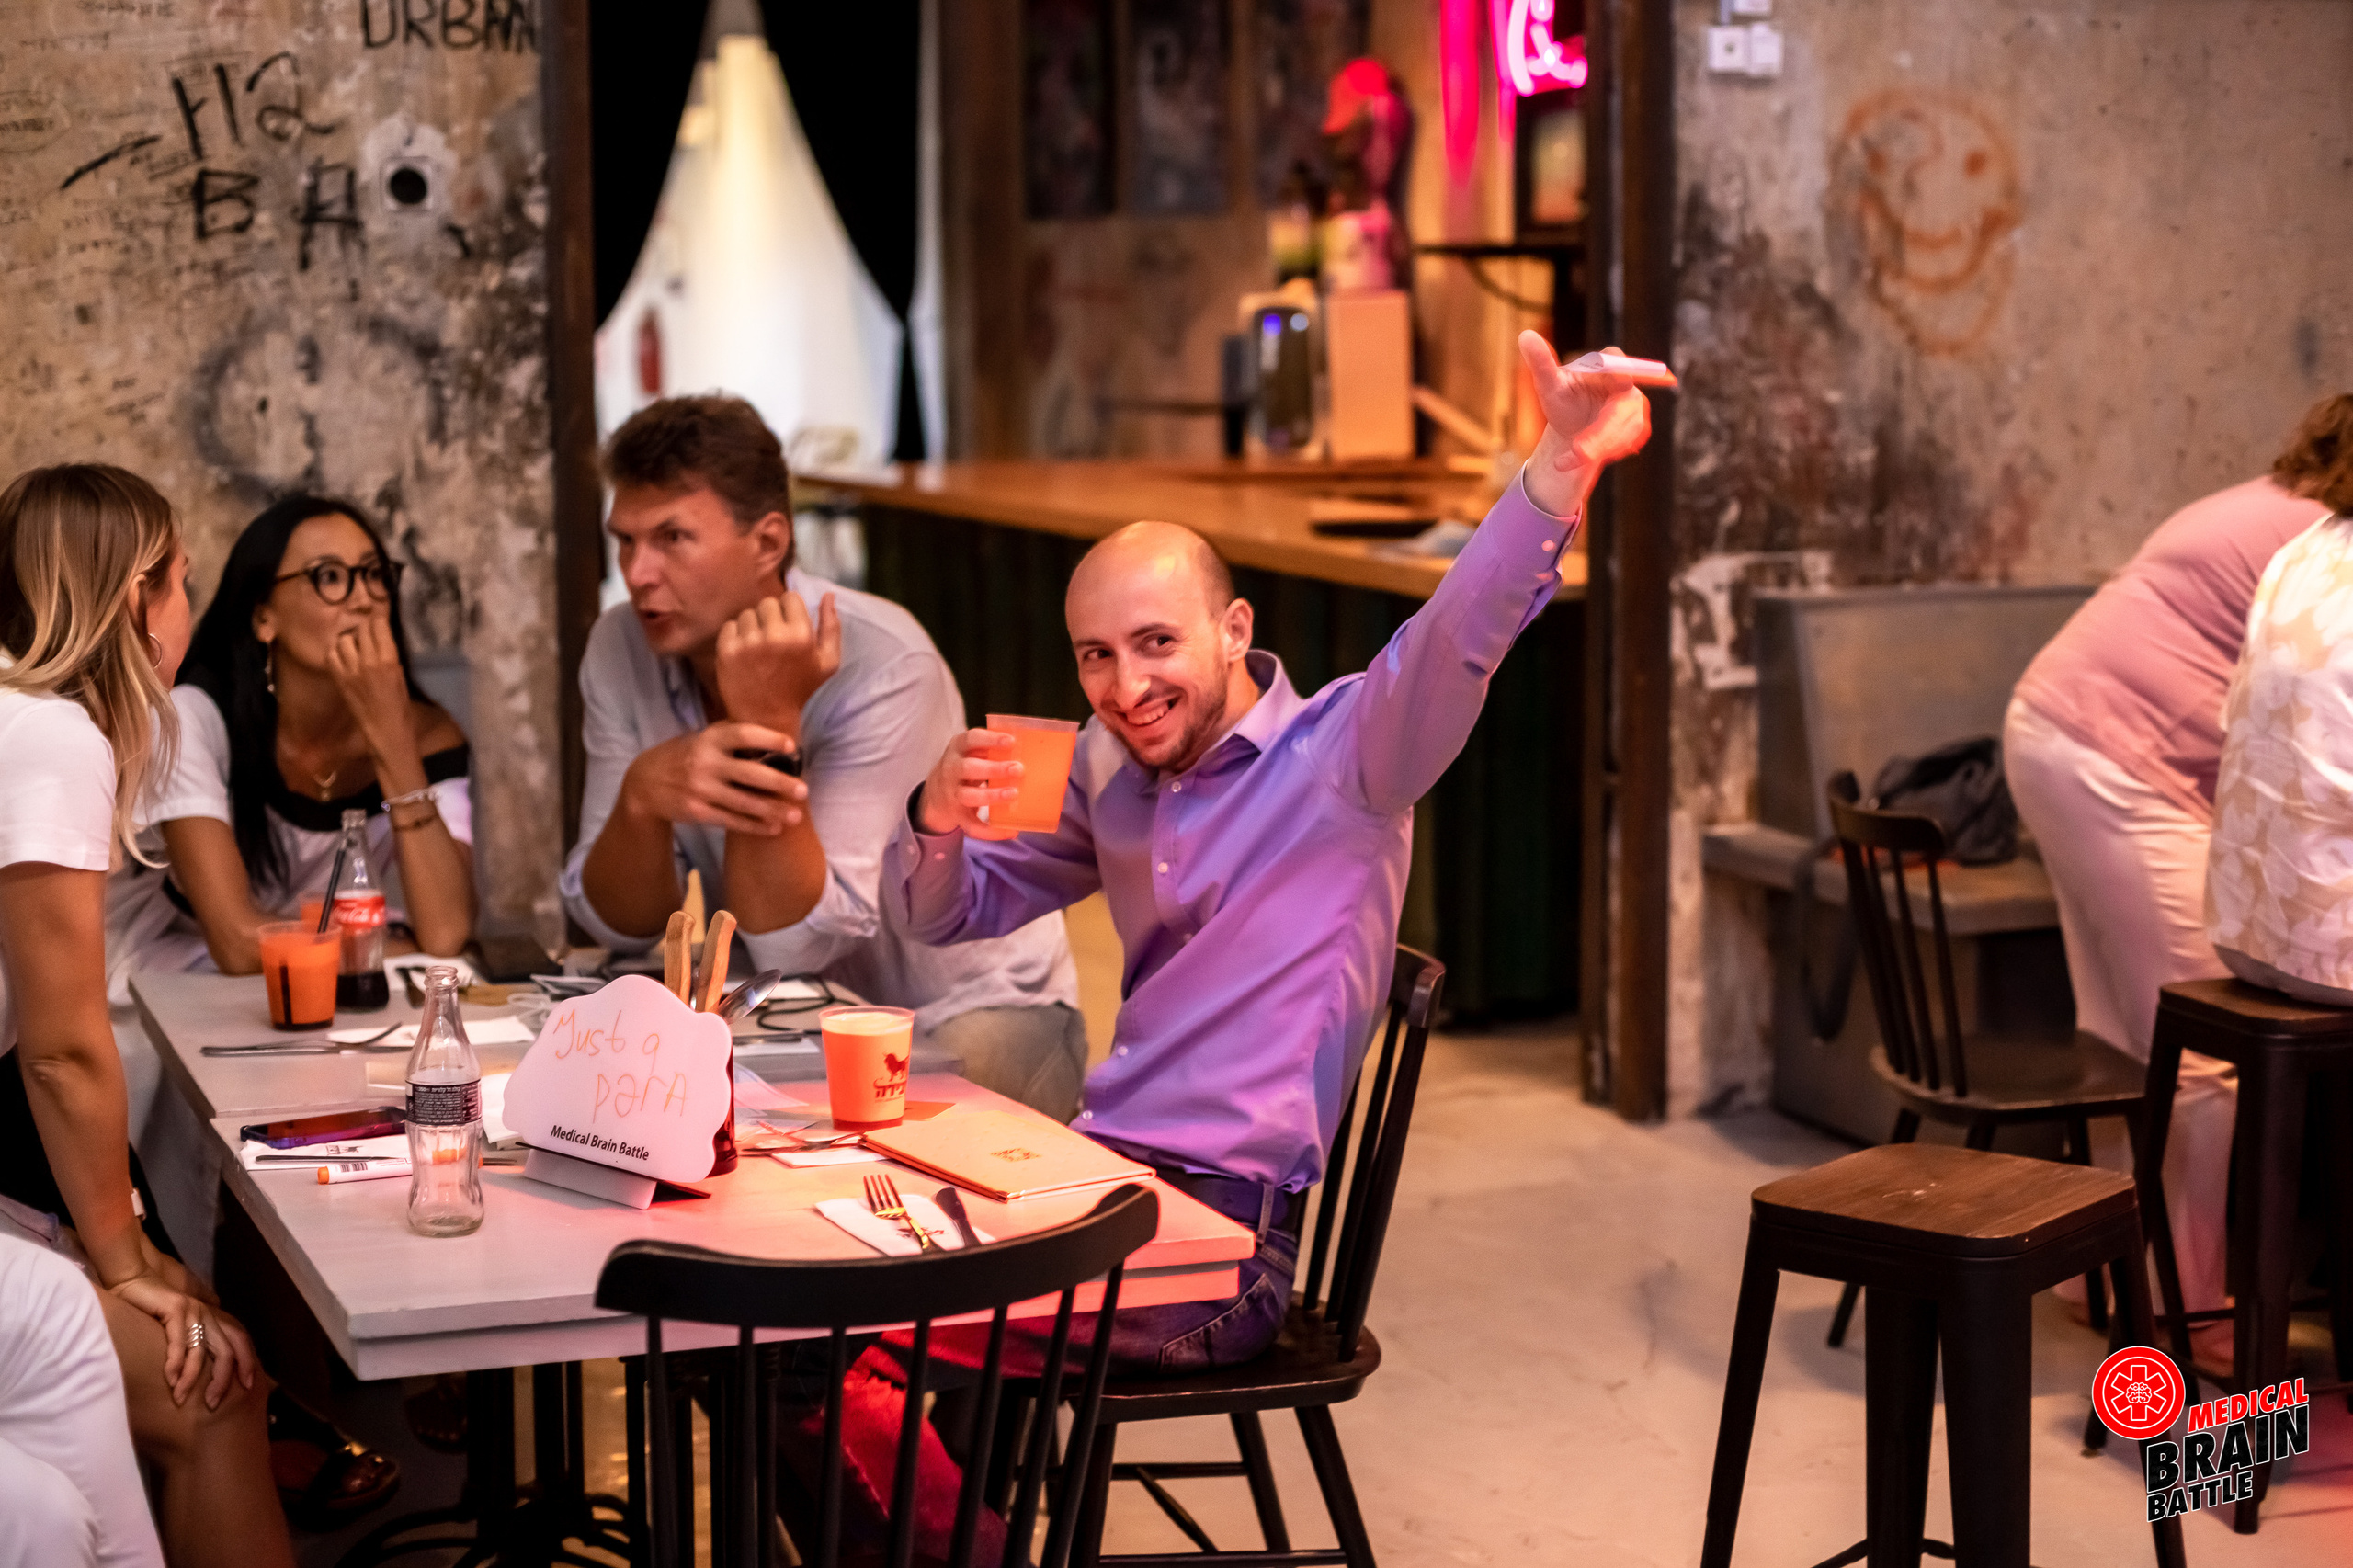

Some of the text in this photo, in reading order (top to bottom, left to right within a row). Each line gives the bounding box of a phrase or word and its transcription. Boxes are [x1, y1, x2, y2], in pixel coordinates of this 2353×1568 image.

[553, 1009, 626, 1060] Just
[551, 1125, 649, 1161] Medical Brain Battle
